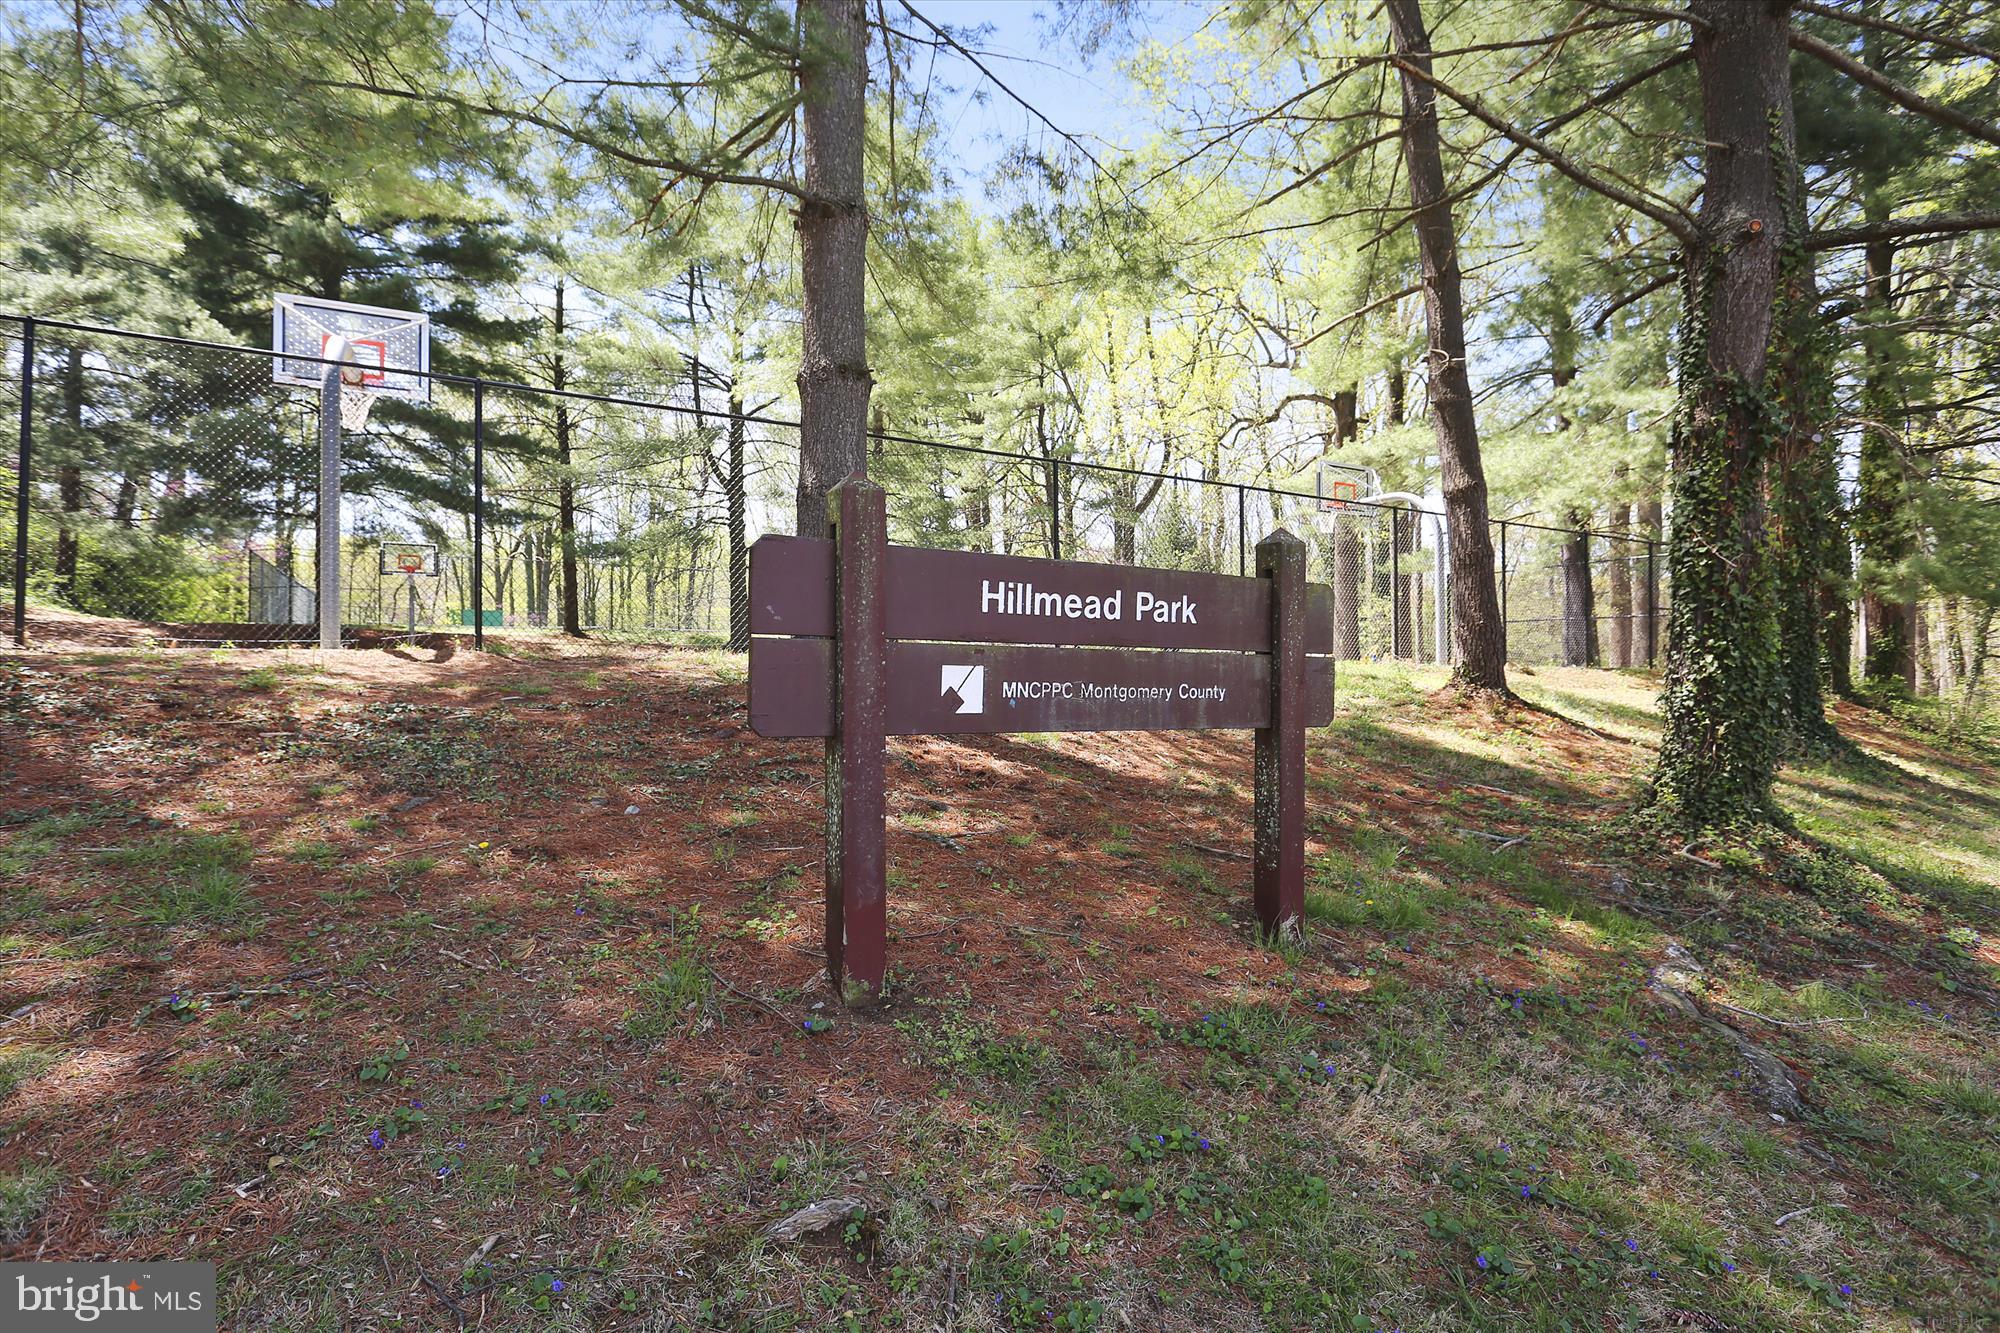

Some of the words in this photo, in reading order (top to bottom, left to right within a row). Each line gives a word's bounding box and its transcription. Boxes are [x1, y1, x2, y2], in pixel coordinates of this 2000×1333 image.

[981, 580, 1122, 621] Hillmead
[1135, 591, 1198, 624] Park
[1002, 681, 1074, 699] MNCPPC
[1080, 682, 1173, 702] Montgomery
[1178, 684, 1227, 702] County
